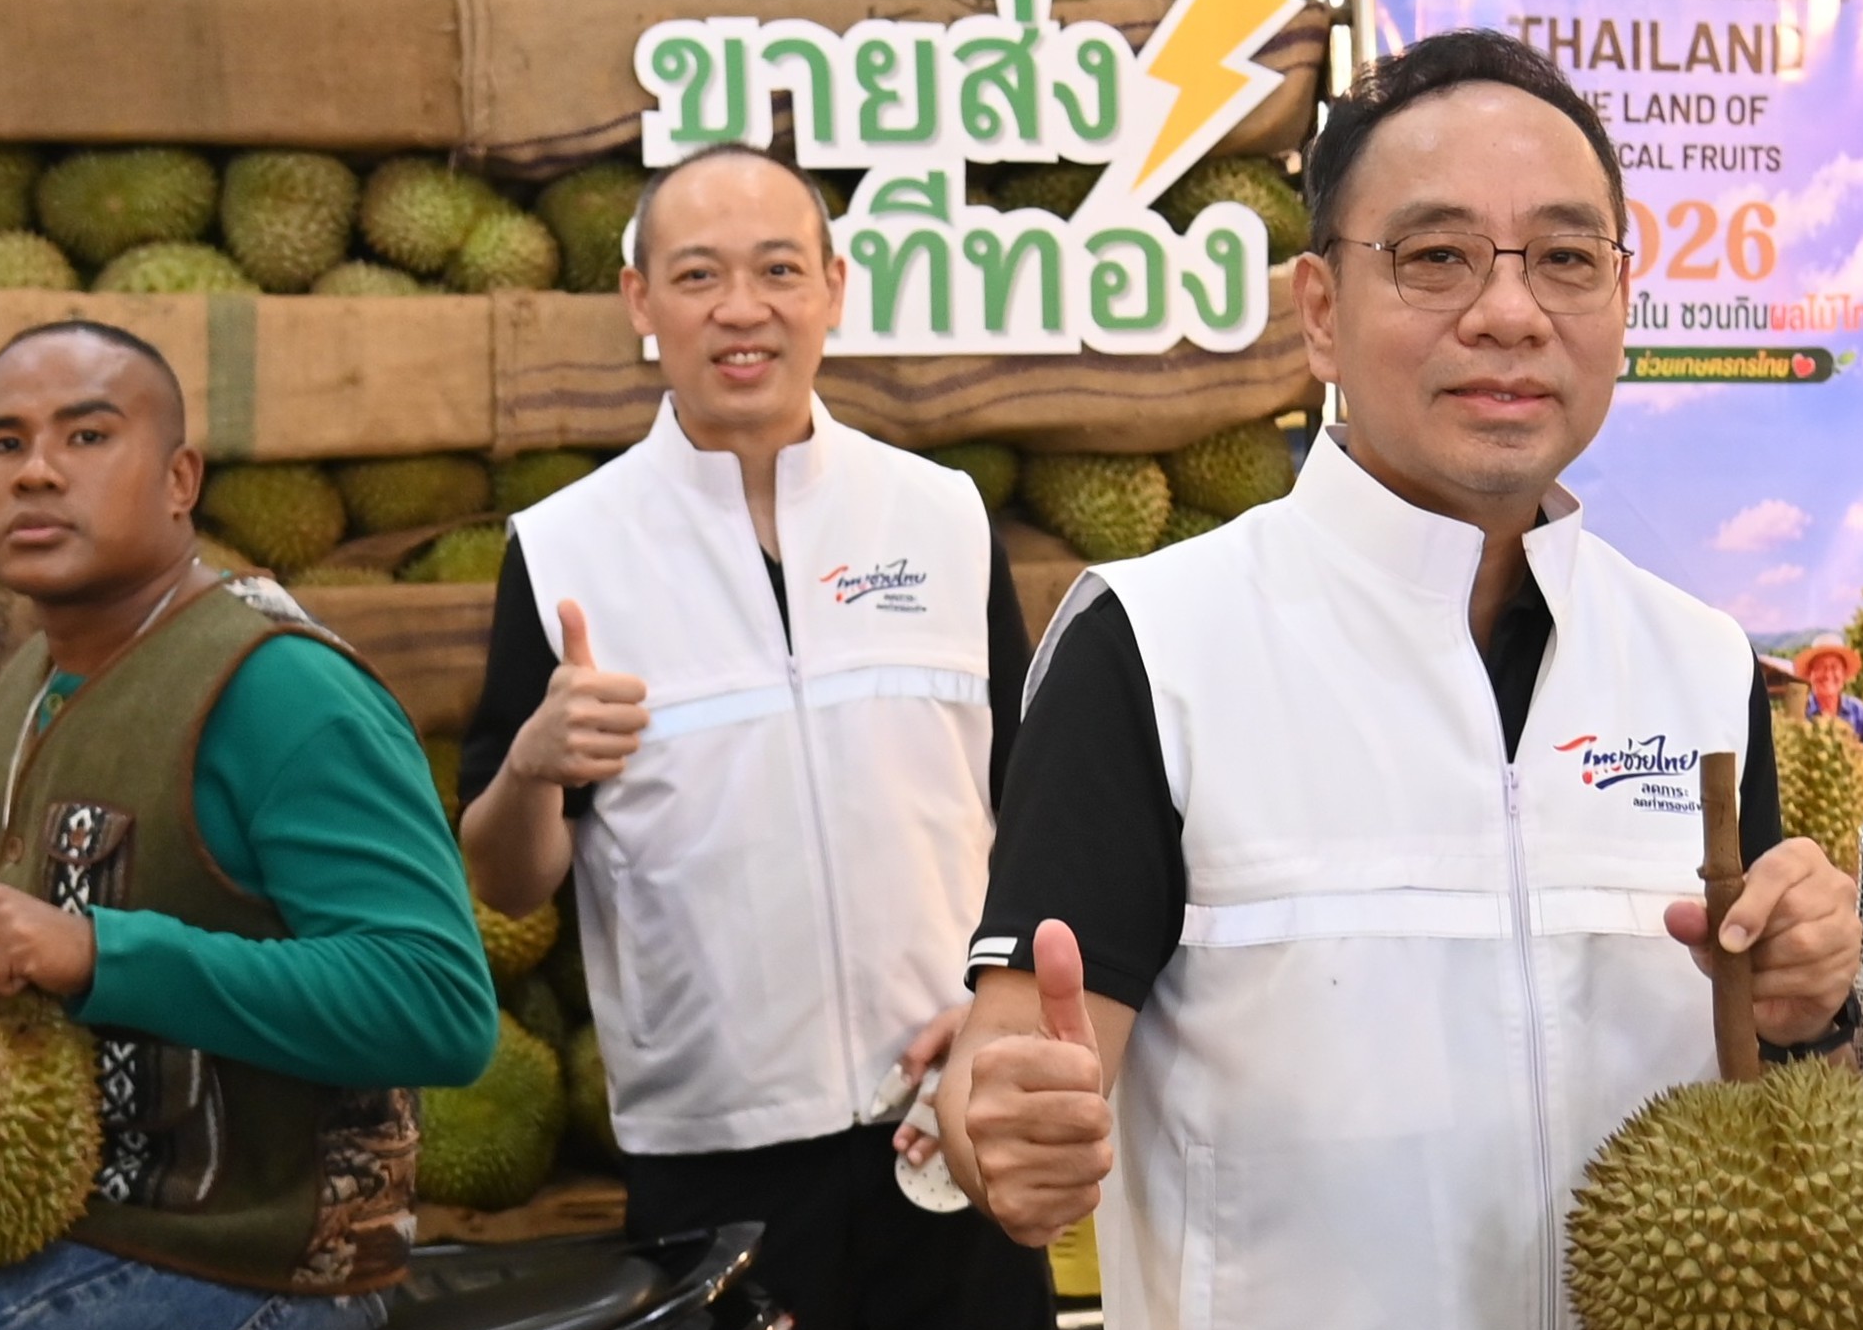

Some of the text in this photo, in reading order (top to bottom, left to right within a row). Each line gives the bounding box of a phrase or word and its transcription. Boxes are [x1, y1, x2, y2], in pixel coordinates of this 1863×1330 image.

[1508, 15, 1804, 76] THAILAND
[1624, 92, 1715, 125] LAND
[1726, 94, 1768, 125] OF
[1682, 142, 1782, 173] FRUITS
[830, 170, 1244, 333] ทีทอง
[1626, 199, 1778, 283] 026
